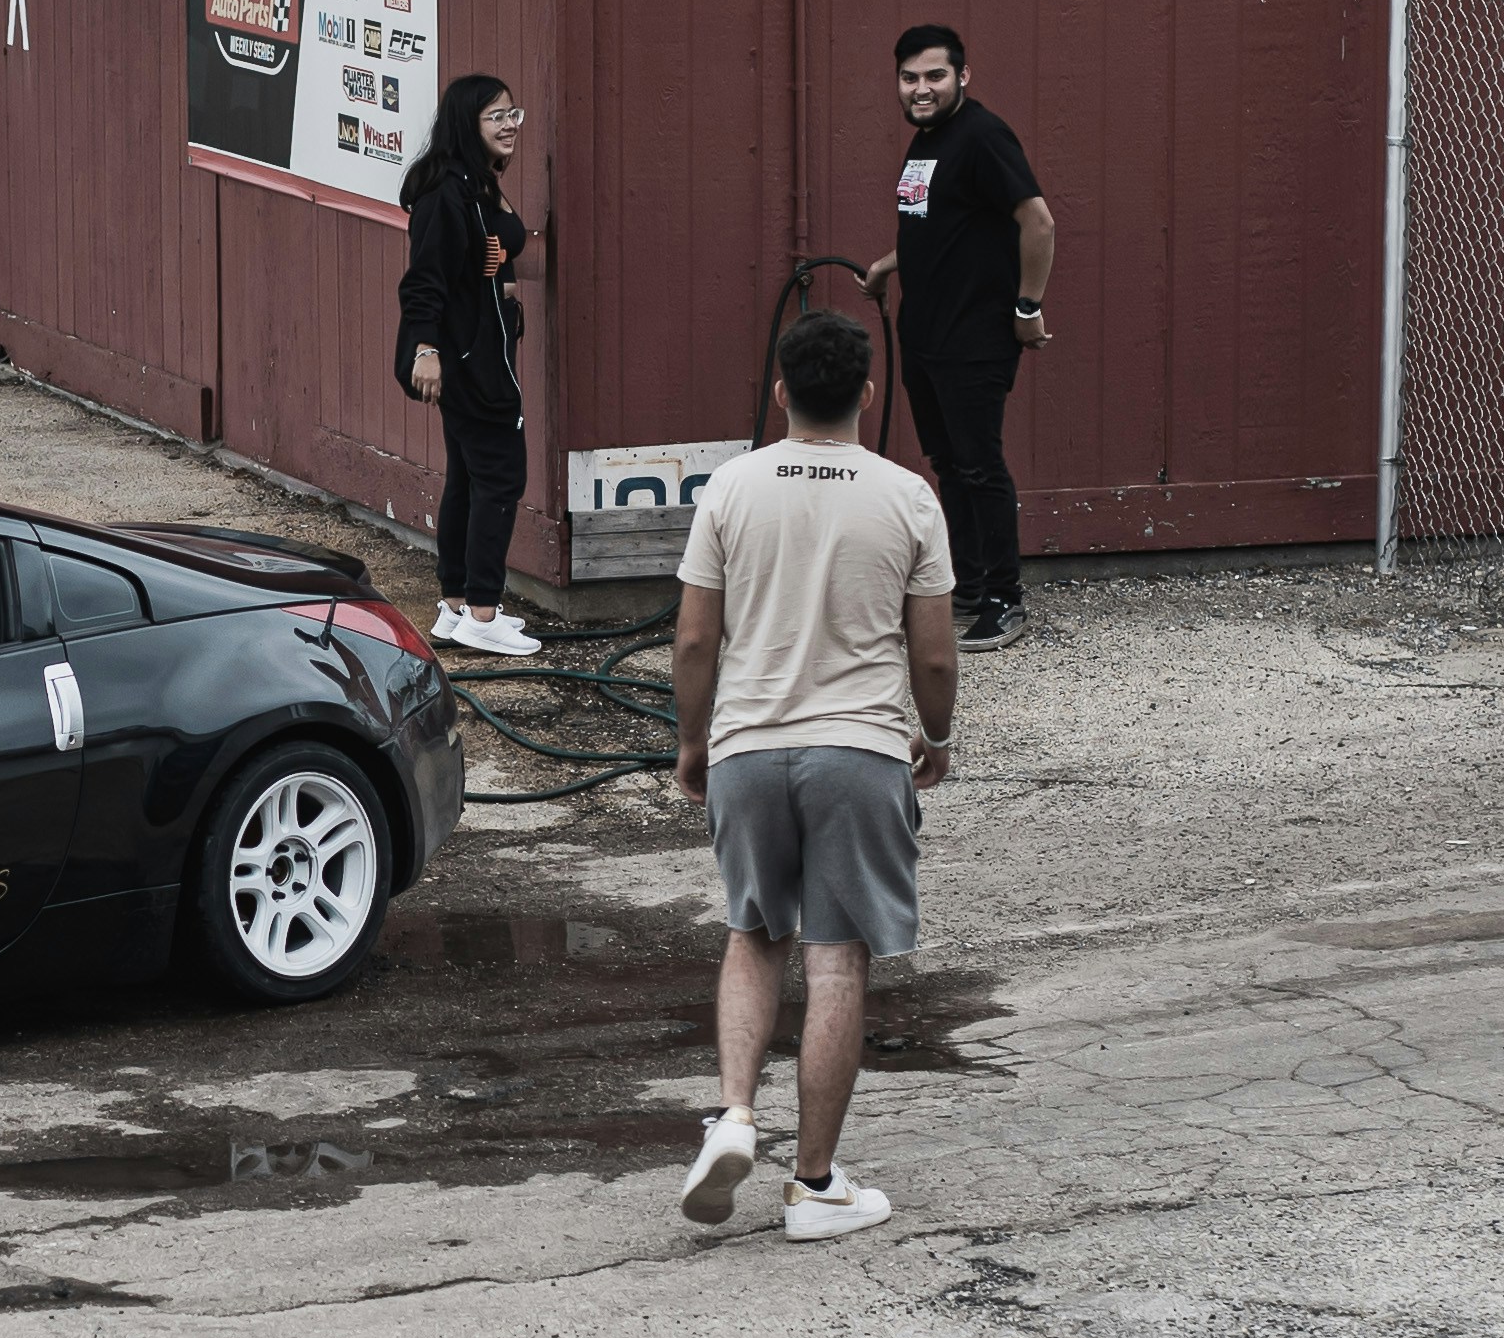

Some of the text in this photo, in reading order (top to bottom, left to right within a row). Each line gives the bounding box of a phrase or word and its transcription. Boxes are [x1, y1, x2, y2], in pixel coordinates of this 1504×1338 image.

[318, 11, 345, 41] Mobil
[229, 35, 275, 63] WEEKLY SERIES
[389, 29, 426, 54] PFC
[343, 68, 374, 88] QUARTER
[348, 82, 376, 102] MASTER
[363, 120, 403, 153] WHELEN
